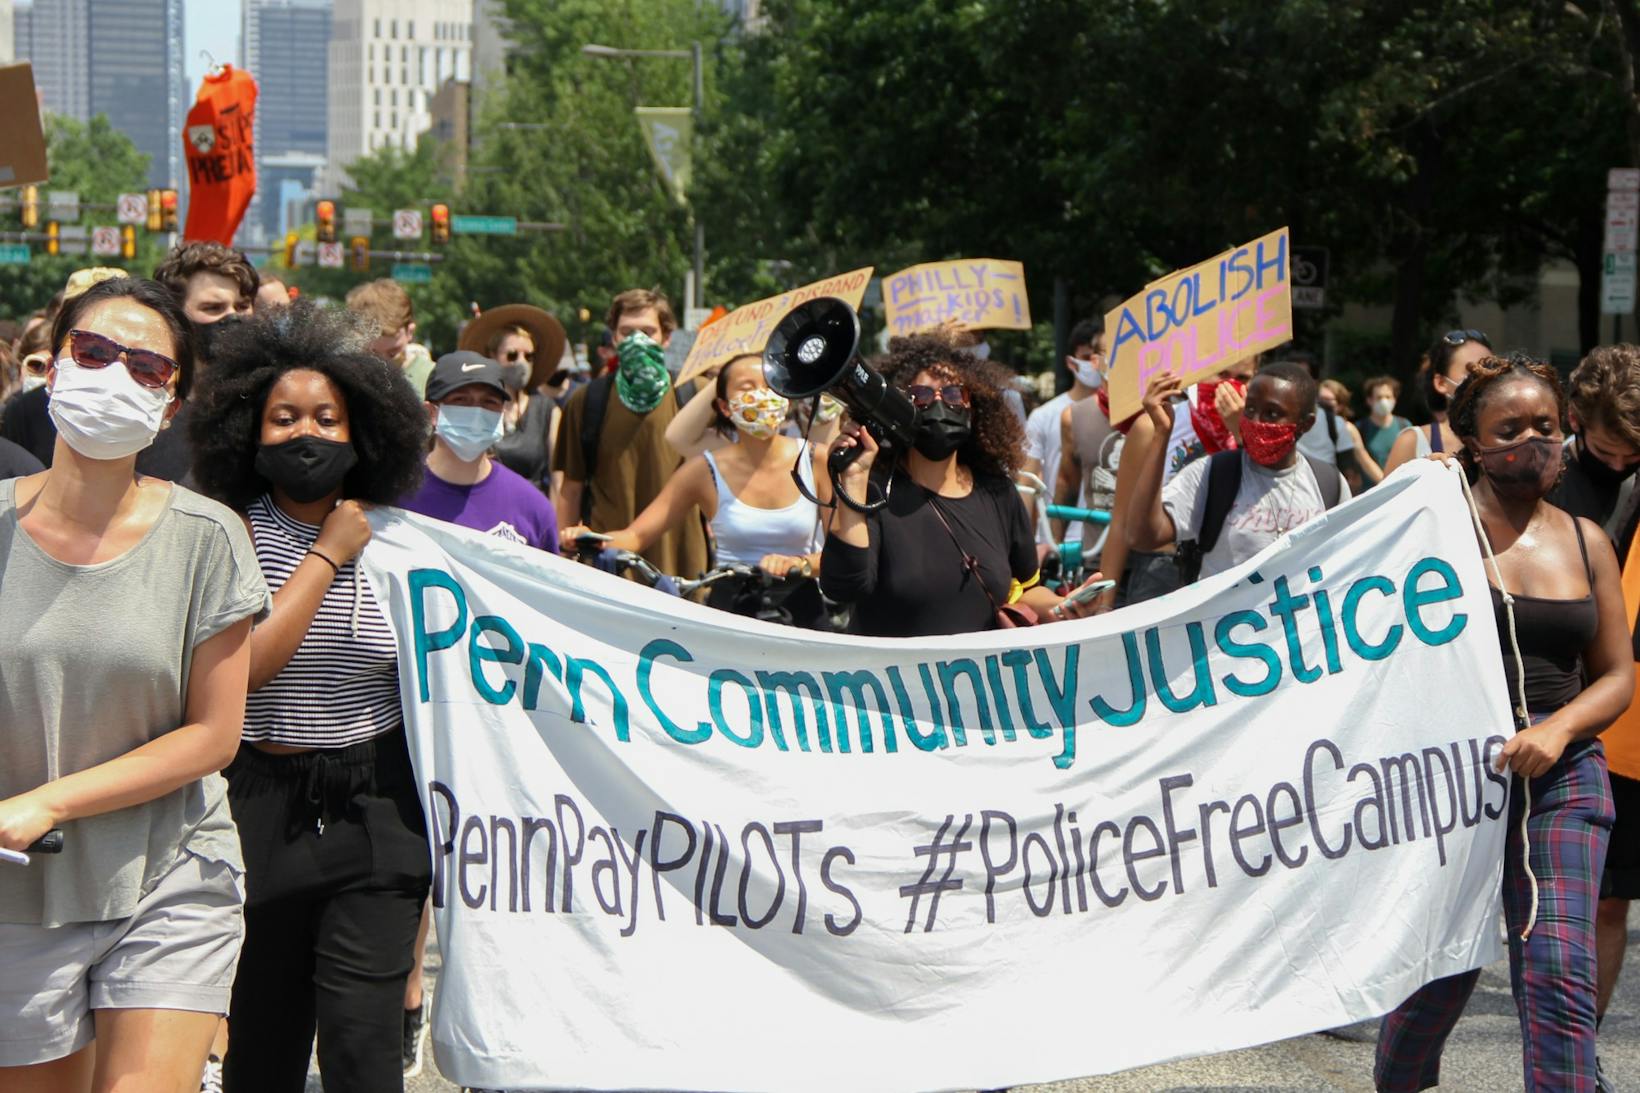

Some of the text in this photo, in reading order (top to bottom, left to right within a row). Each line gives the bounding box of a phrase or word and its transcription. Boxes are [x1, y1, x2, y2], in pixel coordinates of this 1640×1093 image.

[1109, 234, 1286, 369] ABOLISH
[1137, 285, 1289, 397] POLICE
[636, 638, 1080, 769] Community
[1088, 556, 1468, 728] Justice
